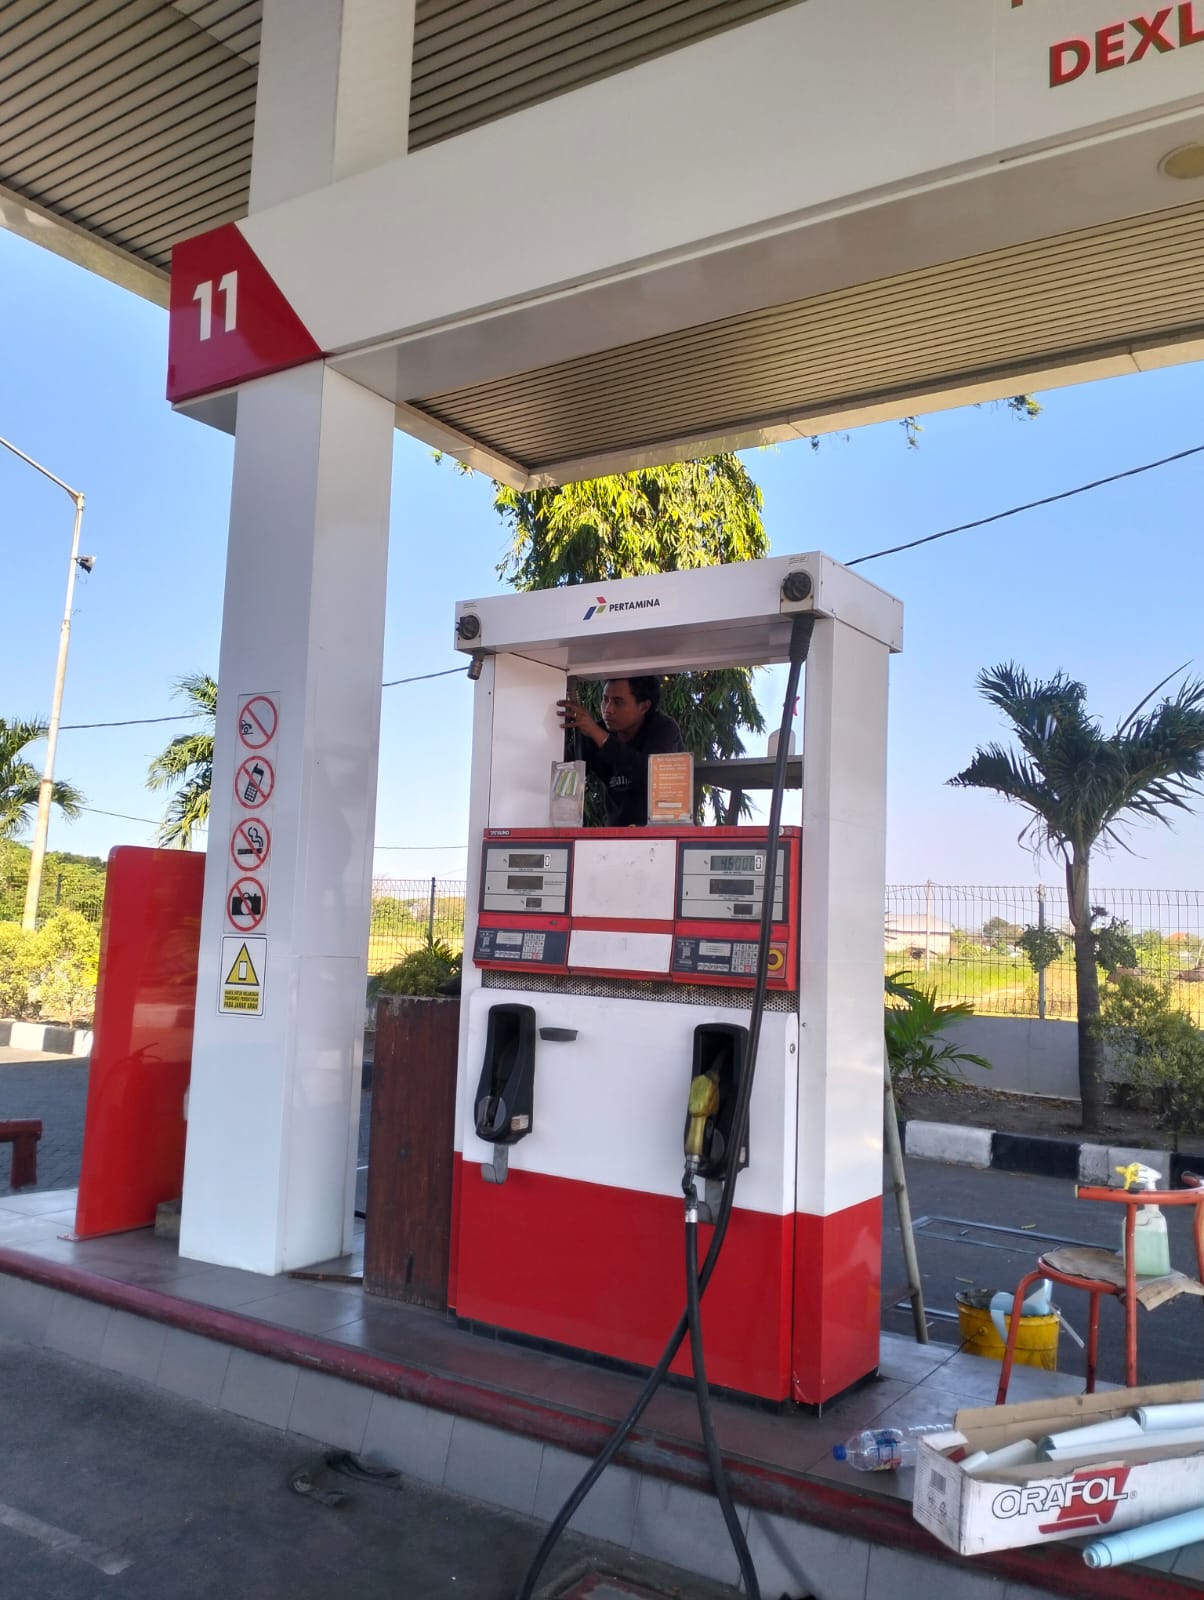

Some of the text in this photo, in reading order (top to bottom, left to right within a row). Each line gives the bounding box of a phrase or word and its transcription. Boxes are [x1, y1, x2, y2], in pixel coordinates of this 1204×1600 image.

[1049, 1, 1204, 88] DEXL
[193, 270, 238, 341] 11
[609, 598, 660, 612] PERTAMINA
[992, 1476, 1129, 1519] ORAFOL
